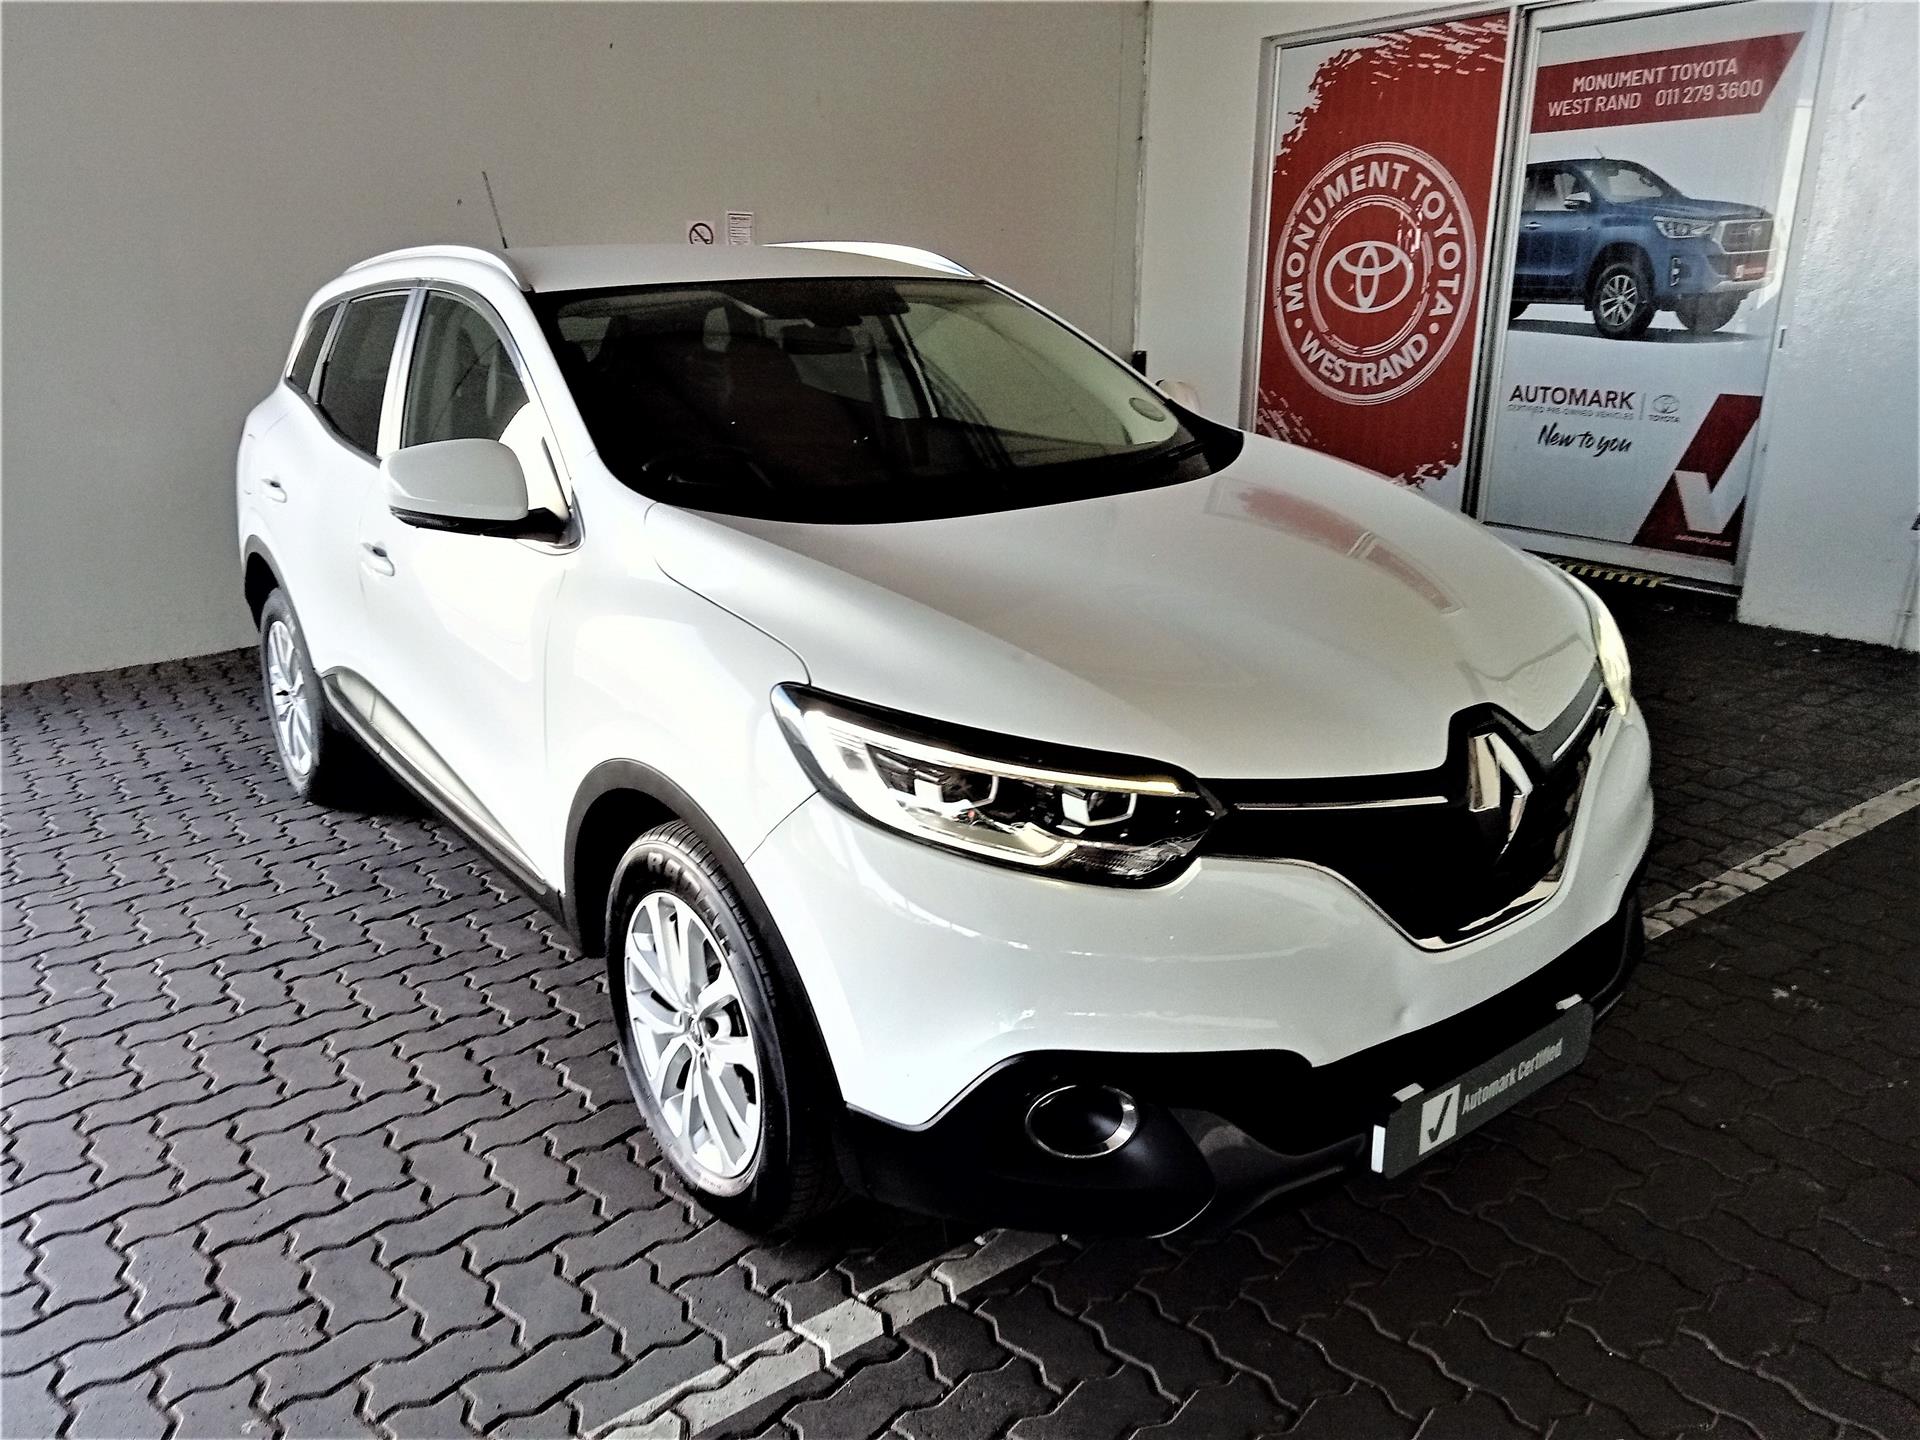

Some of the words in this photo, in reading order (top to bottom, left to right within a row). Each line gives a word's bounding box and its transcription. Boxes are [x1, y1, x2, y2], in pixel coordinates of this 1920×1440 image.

[1572, 66, 1667, 93] MONUMENT
[1670, 57, 1738, 82] TOYOTA
[1548, 97, 1592, 117] WEST
[1595, 92, 1642, 112] RAND
[1655, 88, 1679, 107] 011
[1682, 83, 1713, 104] 279
[1716, 79, 1763, 101] 3600
[1284, 161, 1410, 312] MONUMENT
[1410, 172, 1461, 317] TOYOTA
[1300, 330, 1429, 387] WESTRAND
[1509, 385, 1636, 410] AUTOMARK
[1648, 414, 1681, 423] TOYOTA
[1538, 422, 1577, 447] New
[1577, 431, 1595, 449] to
[1593, 436, 1632, 457] you
[1461, 1067, 1517, 1115] Automark
